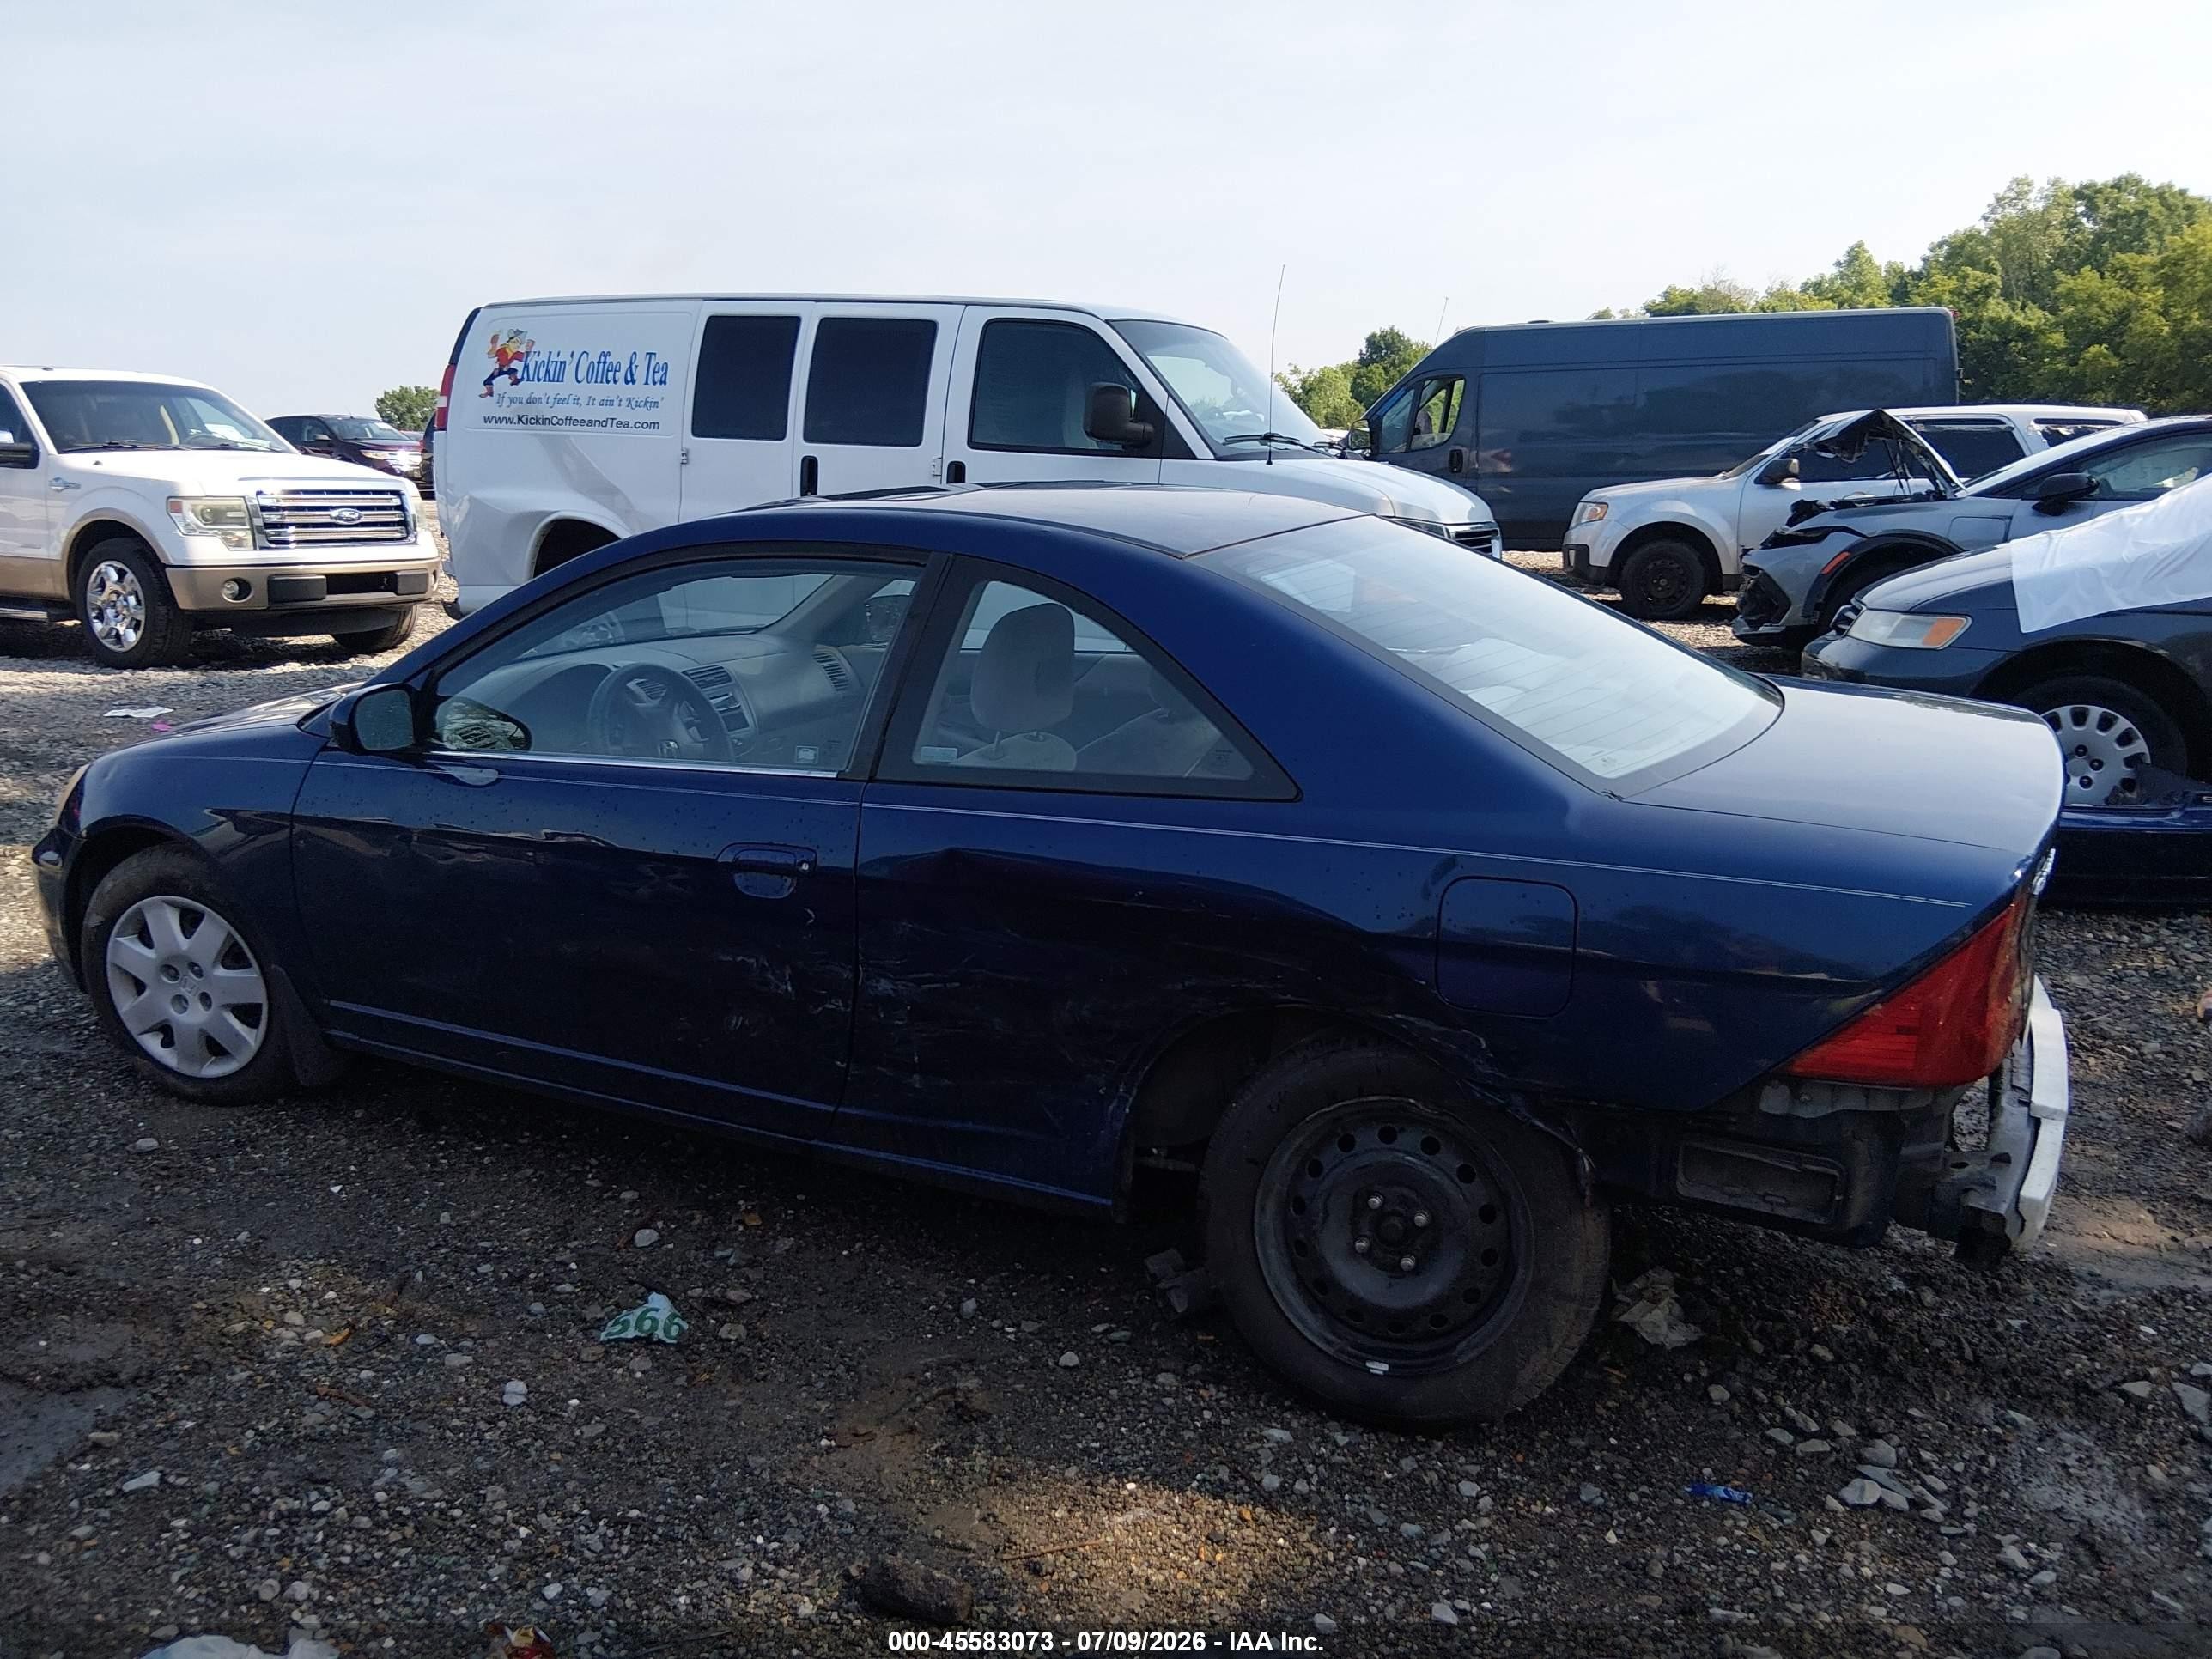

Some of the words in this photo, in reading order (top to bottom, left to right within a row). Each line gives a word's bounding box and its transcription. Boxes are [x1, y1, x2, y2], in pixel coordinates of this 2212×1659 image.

[520, 350, 574, 383] Kickin'
[574, 350, 622, 385] Coffee
[624, 350, 639, 386] &
[643, 351, 669, 386] Tea
[495, 392, 507, 407] If
[507, 396, 524, 408] you
[526, 392, 550, 404] don't
[550, 393, 571, 408] feel
[572, 394, 582, 408] it,
[586, 395, 596, 406] It
[599, 395, 623, 408] ain't
[483, 414, 660, 430] www.KickinCoffeeandTea.com
